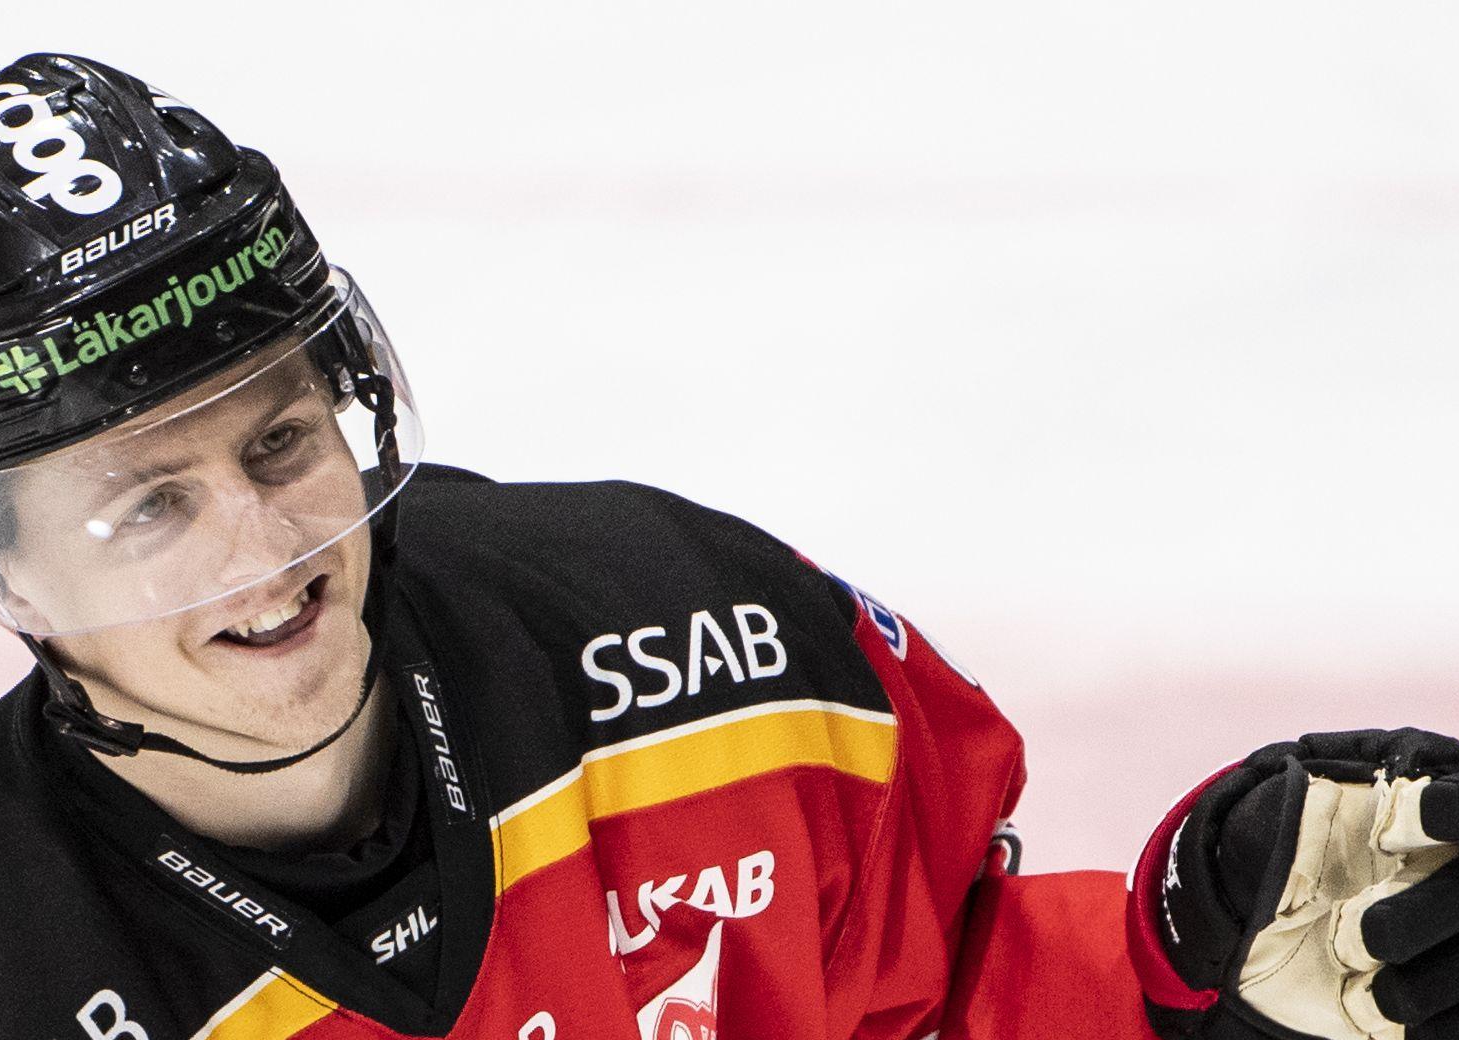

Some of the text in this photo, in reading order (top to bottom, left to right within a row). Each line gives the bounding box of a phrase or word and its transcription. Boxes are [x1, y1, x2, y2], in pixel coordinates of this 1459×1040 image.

[61, 203, 178, 276] BAUER
[42, 226, 289, 377] Läkarjouren
[581, 603, 787, 722] SSAB
[413, 673, 467, 812] BAUER
[157, 849, 290, 937] BAUER
[370, 905, 439, 965] SHL
[605, 850, 775, 956] LKAB
